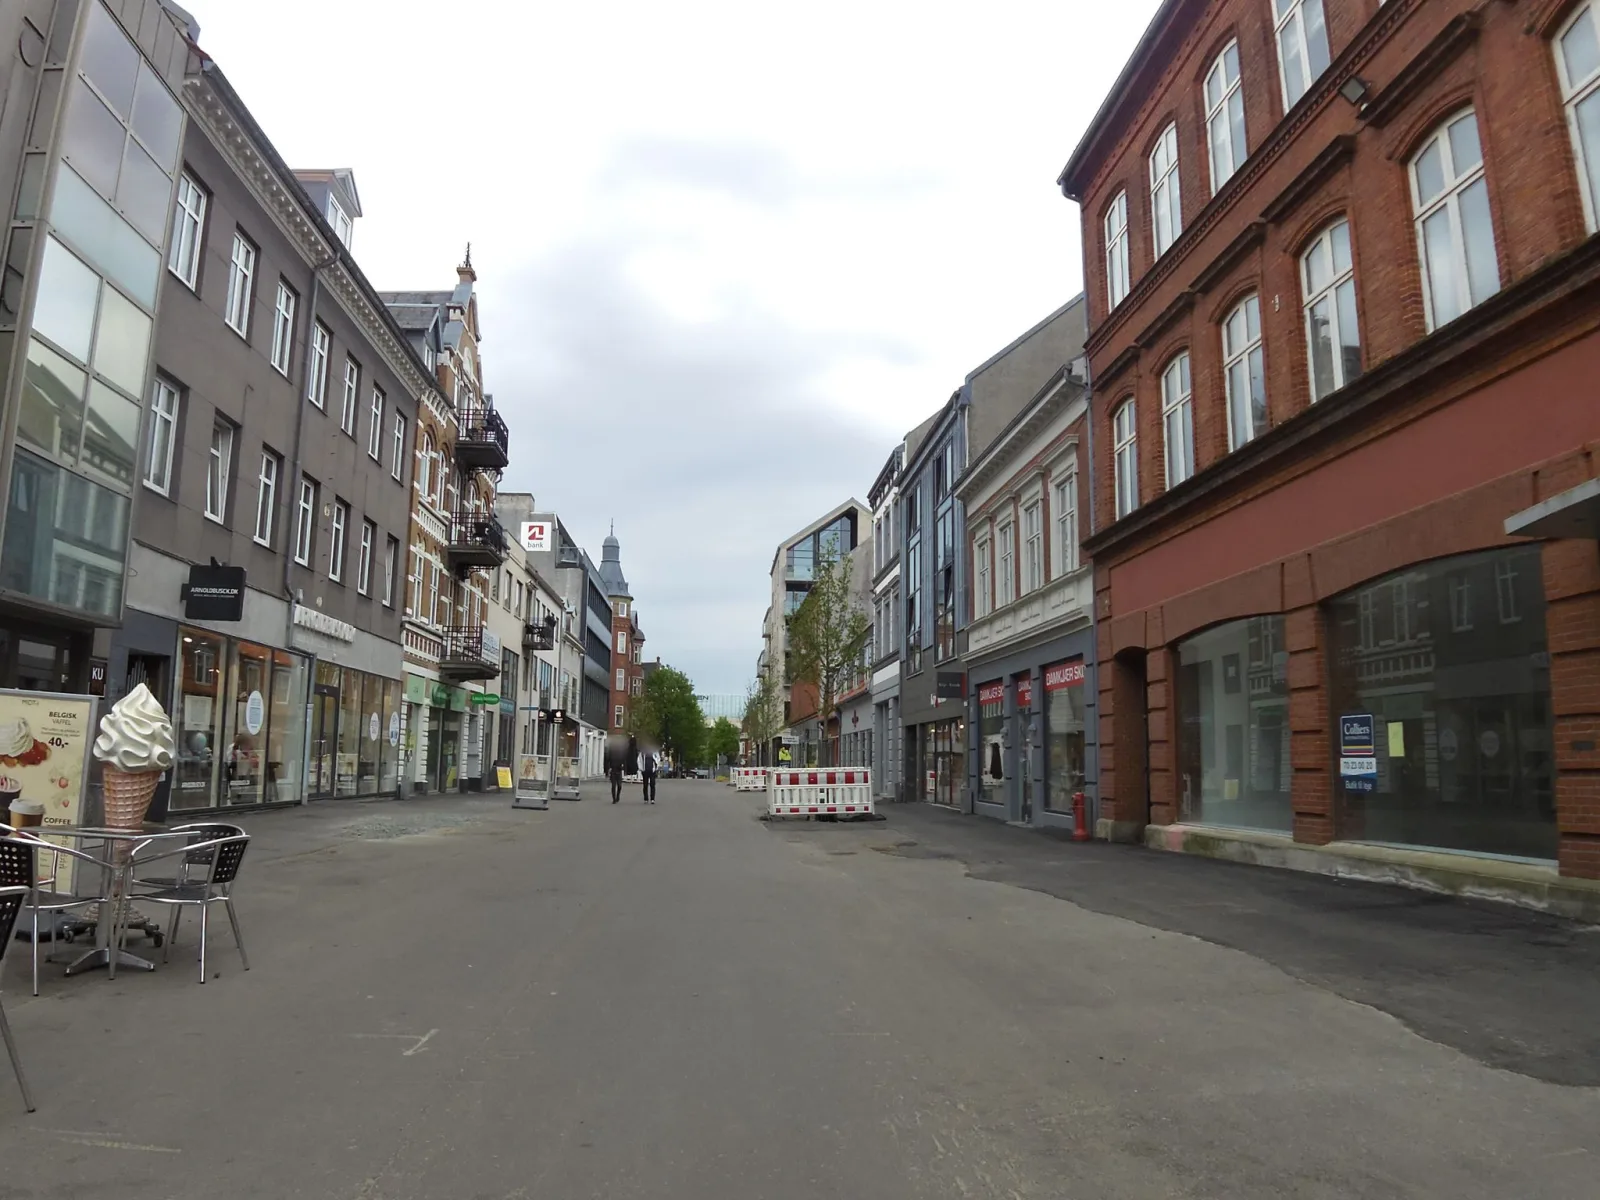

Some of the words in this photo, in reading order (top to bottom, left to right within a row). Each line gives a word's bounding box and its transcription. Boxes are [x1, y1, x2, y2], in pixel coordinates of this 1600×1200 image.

[92, 667, 104, 680] KU
[48, 711, 77, 719] BELGISK
[1344, 723, 1370, 735] Colliers
[48, 737, 69, 748] 40,-
[44, 817, 72, 825] COFFEE
